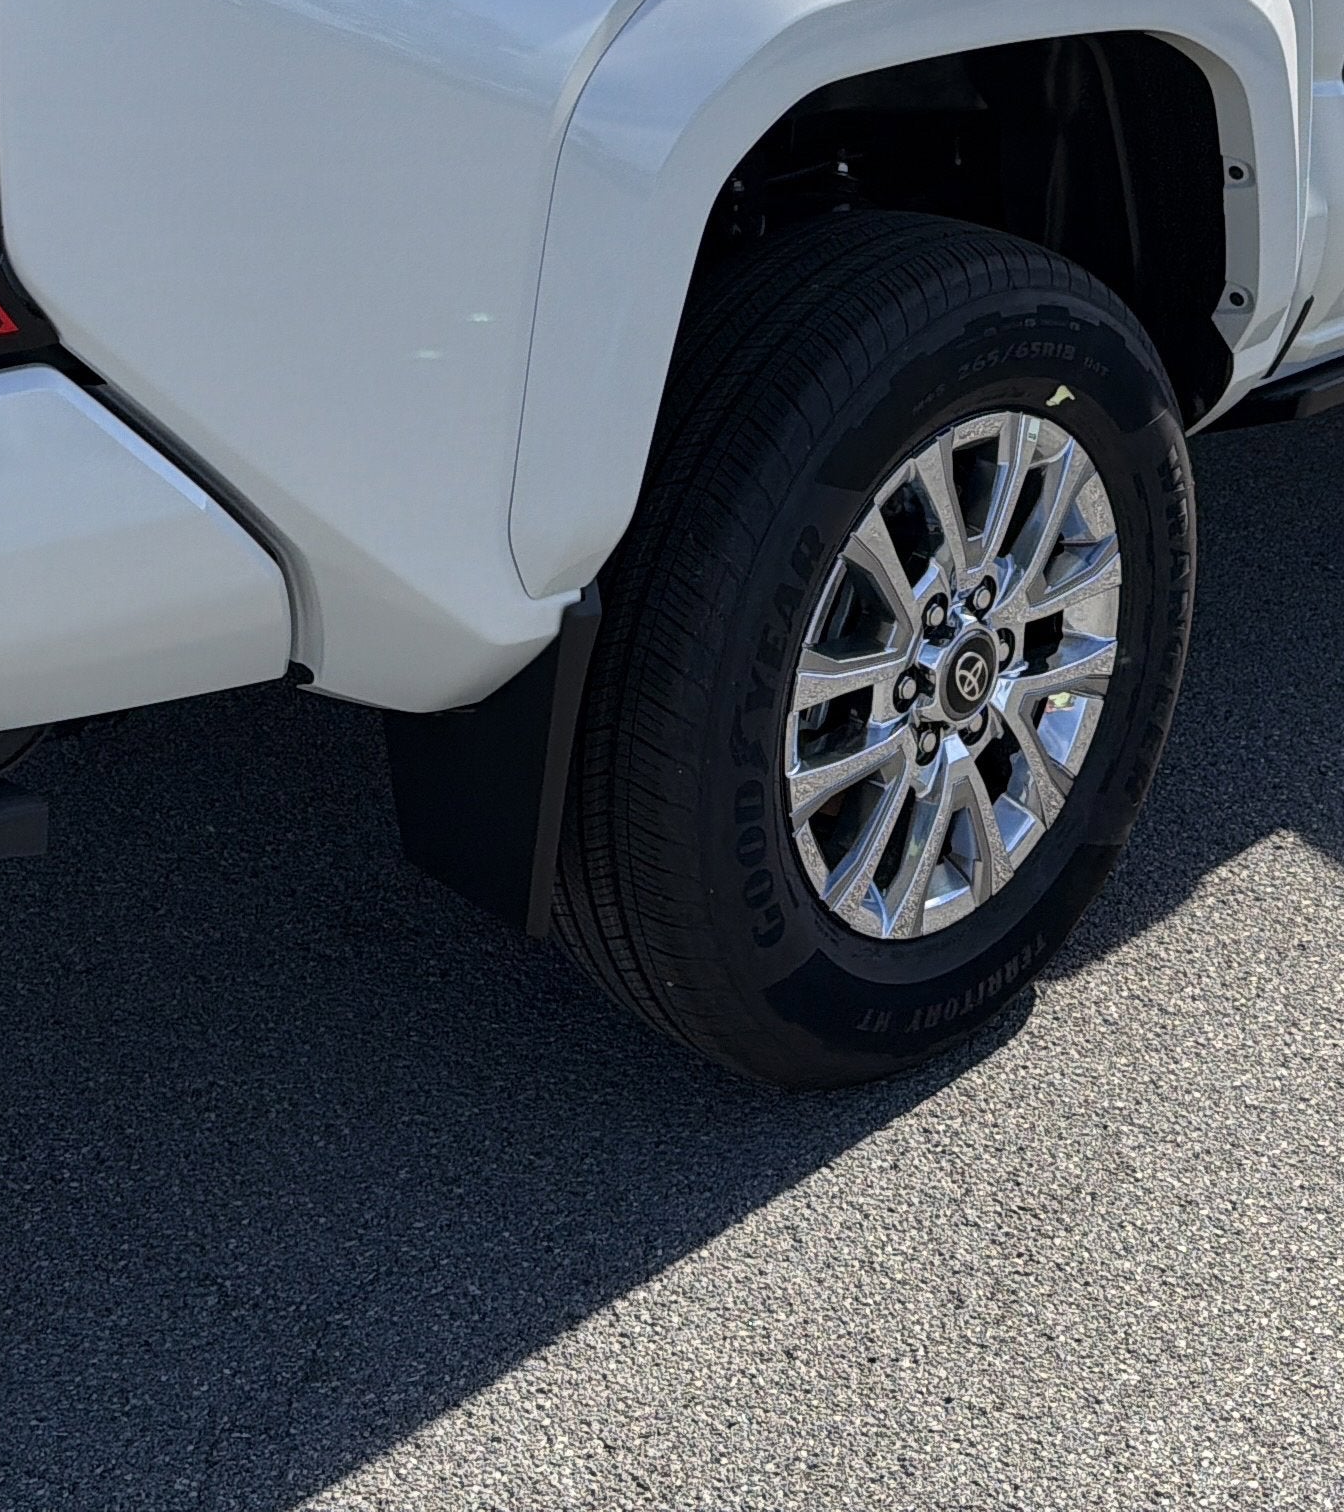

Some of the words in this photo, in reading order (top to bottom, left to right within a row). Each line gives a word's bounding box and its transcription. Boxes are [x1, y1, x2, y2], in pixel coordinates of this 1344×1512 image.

[958, 341, 1075, 381] 265/65R18
[729, 524, 824, 949] GOODYEAR
[903, 932, 1047, 1034] TERRITORY
